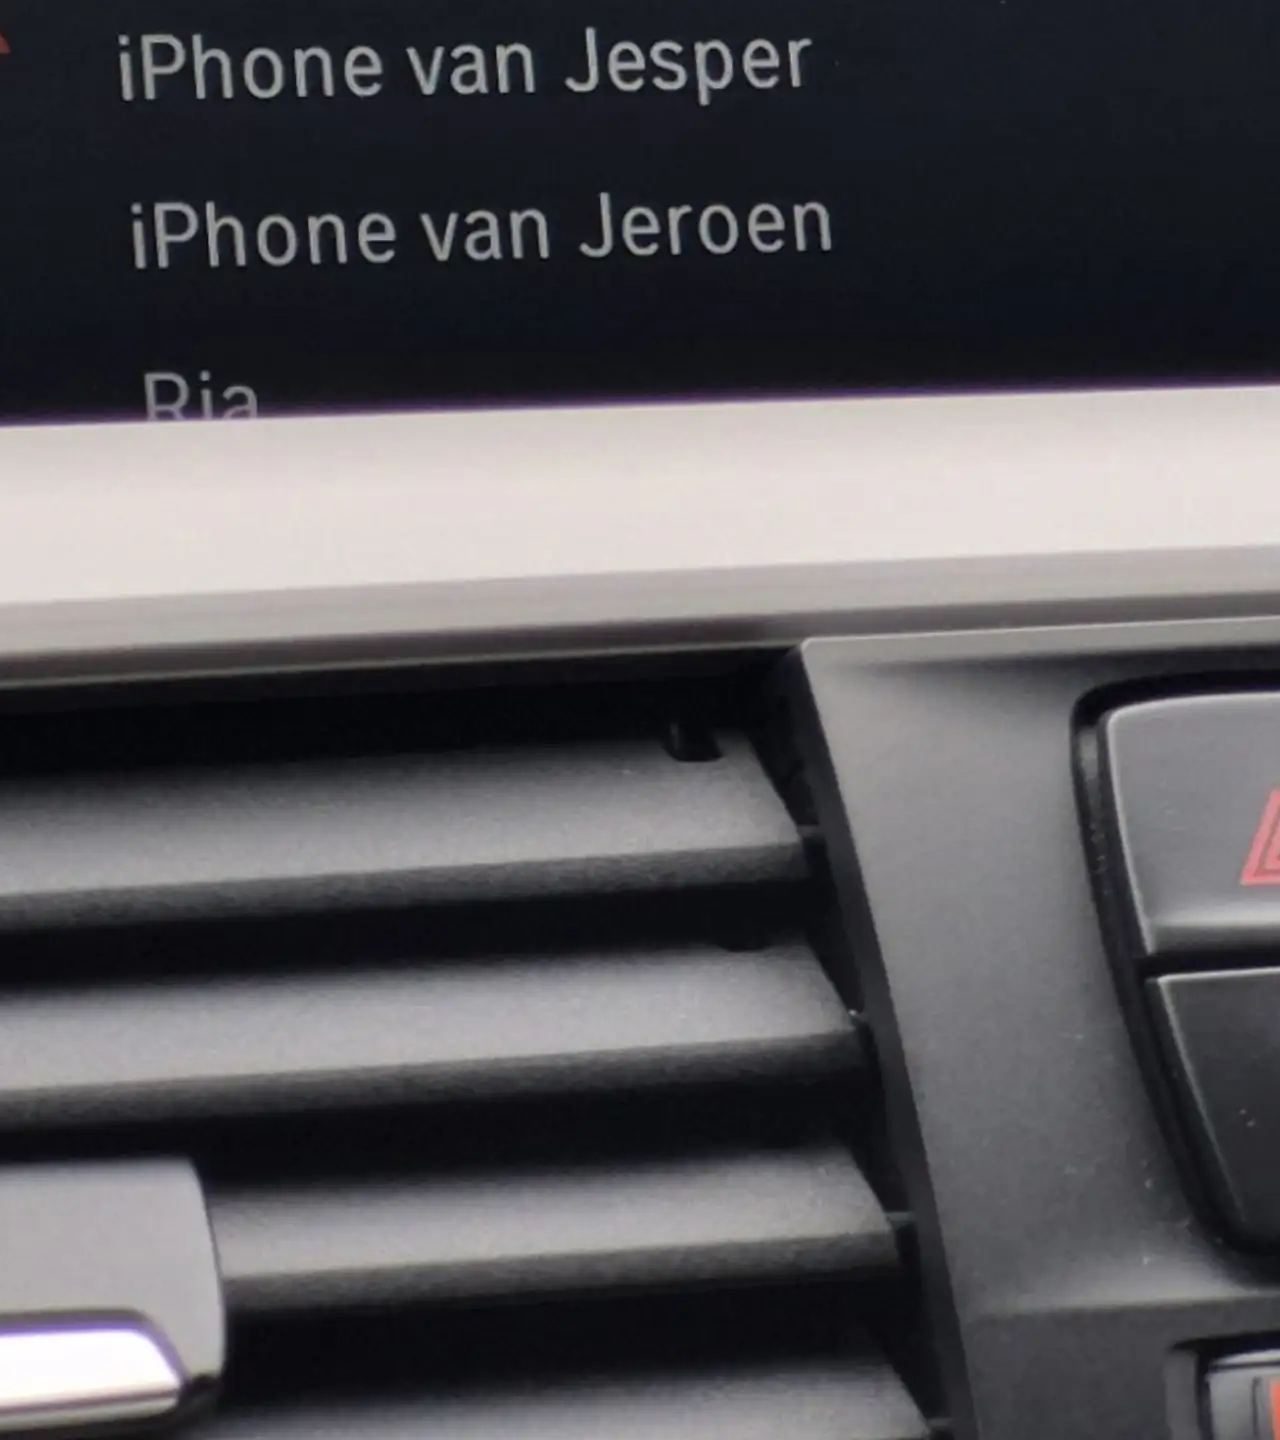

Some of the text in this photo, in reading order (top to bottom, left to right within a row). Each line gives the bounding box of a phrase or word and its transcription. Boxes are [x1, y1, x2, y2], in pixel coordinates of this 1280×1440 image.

[117, 26, 813, 106] iPhone van Jesper
[130, 190, 833, 270] iPhone van Jeroen
[144, 370, 259, 421] Ria
